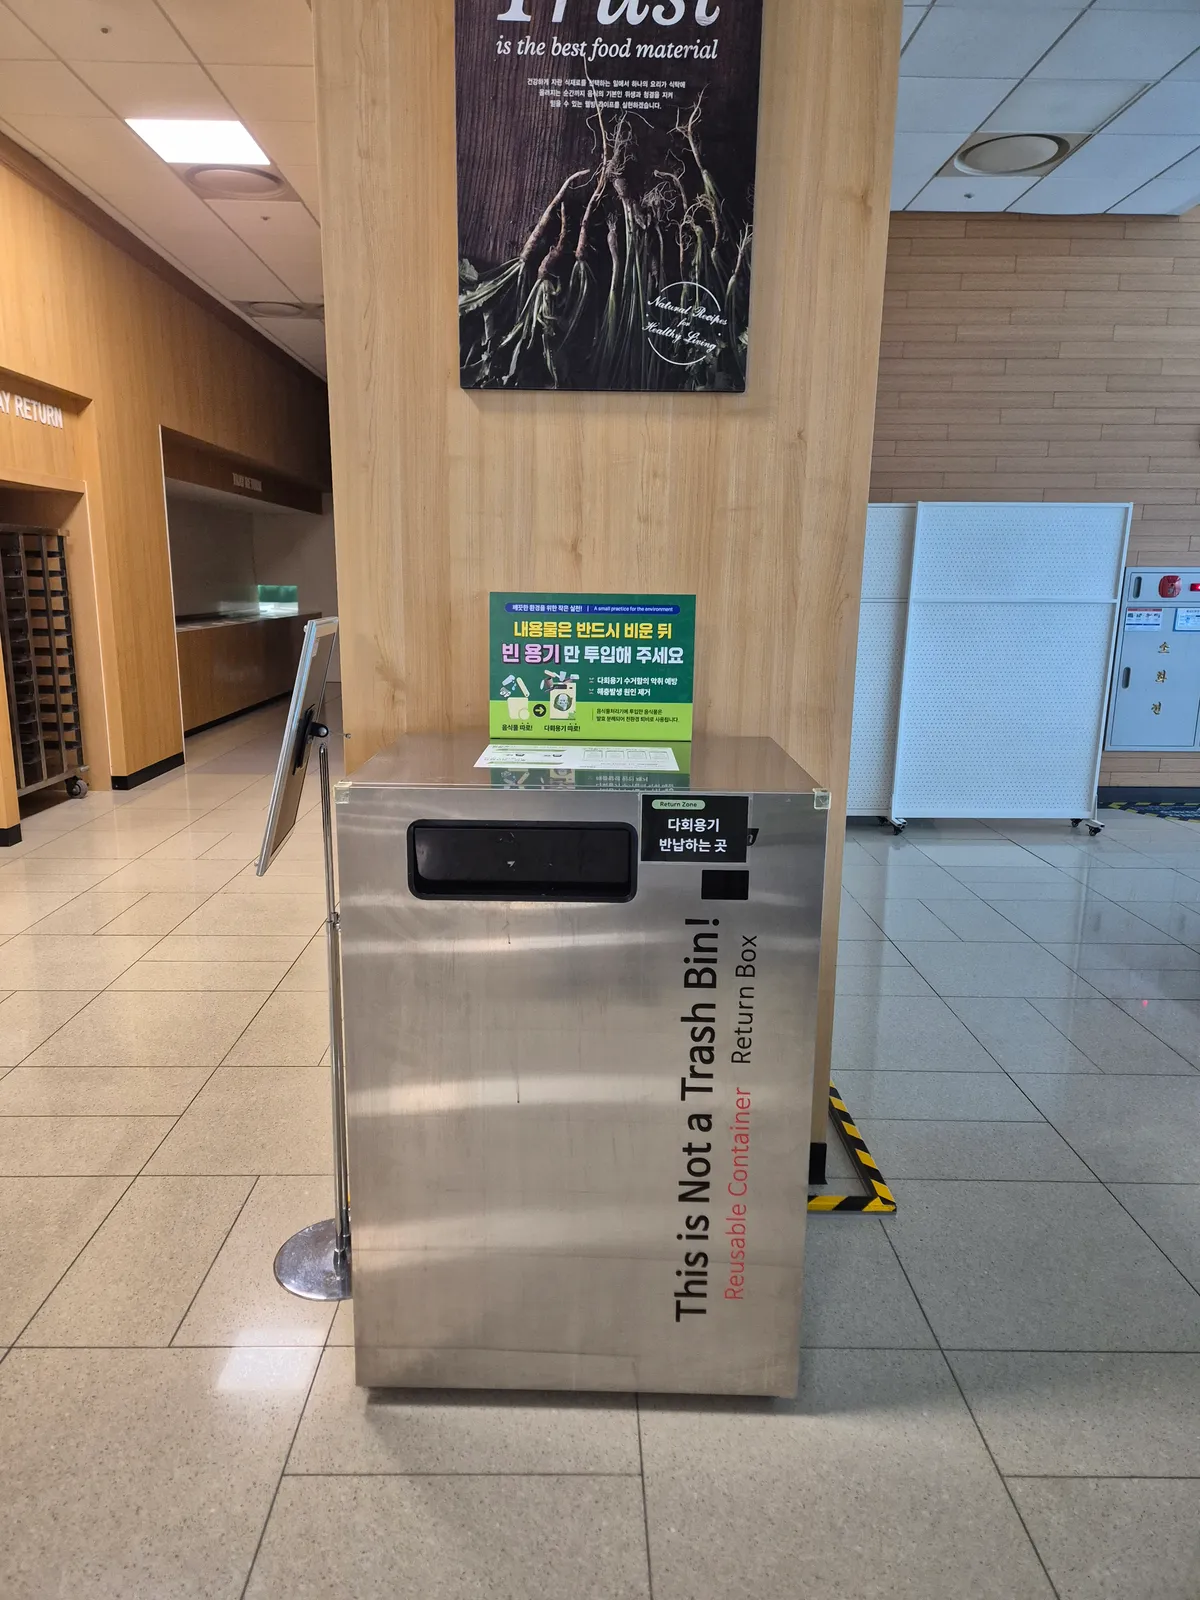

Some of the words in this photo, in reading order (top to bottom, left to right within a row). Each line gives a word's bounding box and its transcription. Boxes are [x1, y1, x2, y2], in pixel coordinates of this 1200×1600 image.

[496, 35, 511, 55] is
[517, 36, 545, 56] the
[551, 37, 587, 57] best
[587, 37, 632, 61] food
[636, 39, 719, 60] material
[527, 78, 549, 86] 건강하게
[631, 80, 648, 88] 하나의
[563, 89, 585, 97] 순간까지
[606, 90, 623, 98] 기본인
[647, 296, 692, 315] Natural
[692, 306, 728, 325] Recipes
[677, 318, 691, 327] for
[642, 321, 681, 344] Healthy
[683, 331, 717, 353] Living
[14, 394, 63, 430] RETURN
[512, 604, 529, 612] 깨끗한
[529, 604, 546, 612] 환경을
[514, 621, 572, 638] 내용물은
[576, 622, 620, 638] 반드시
[624, 623, 653, 639] 비운
[657, 623, 672, 639] 뒤
[502, 643, 520, 663] 빈
[583, 646, 632, 664] 투입해
[636, 647, 684, 664] 주세요
[597, 676, 623, 685] 다회용기
[624, 677, 649, 685] 수거함의
[650, 677, 664, 685] 악취
[664, 677, 678, 686] 예방
[597, 688, 623, 696] 해충발생
[624, 688, 637, 696] 원인
[637, 688, 651, 696] 제거
[519, 722, 533, 731] 따로!
[544, 724, 567, 732] 다회용기
[567, 723, 581, 732] 따로!
[667, 817, 720, 832] 다회용기
[659, 838, 712, 853] 반납하는
[714, 839, 728, 853] 곳
[683, 918, 720, 989] Bin!
[735, 935, 757, 978] Box
[731, 986, 755, 1064] Return
[680, 1003, 716, 1101] Trash
[687, 1113, 713, 1132] a
[728, 1087, 751, 1196] Container
[678, 1142, 712, 1203] Not
[676, 1215, 710, 1241] is
[724, 1204, 747, 1300] Reusable
[674, 1251, 709, 1323] This
